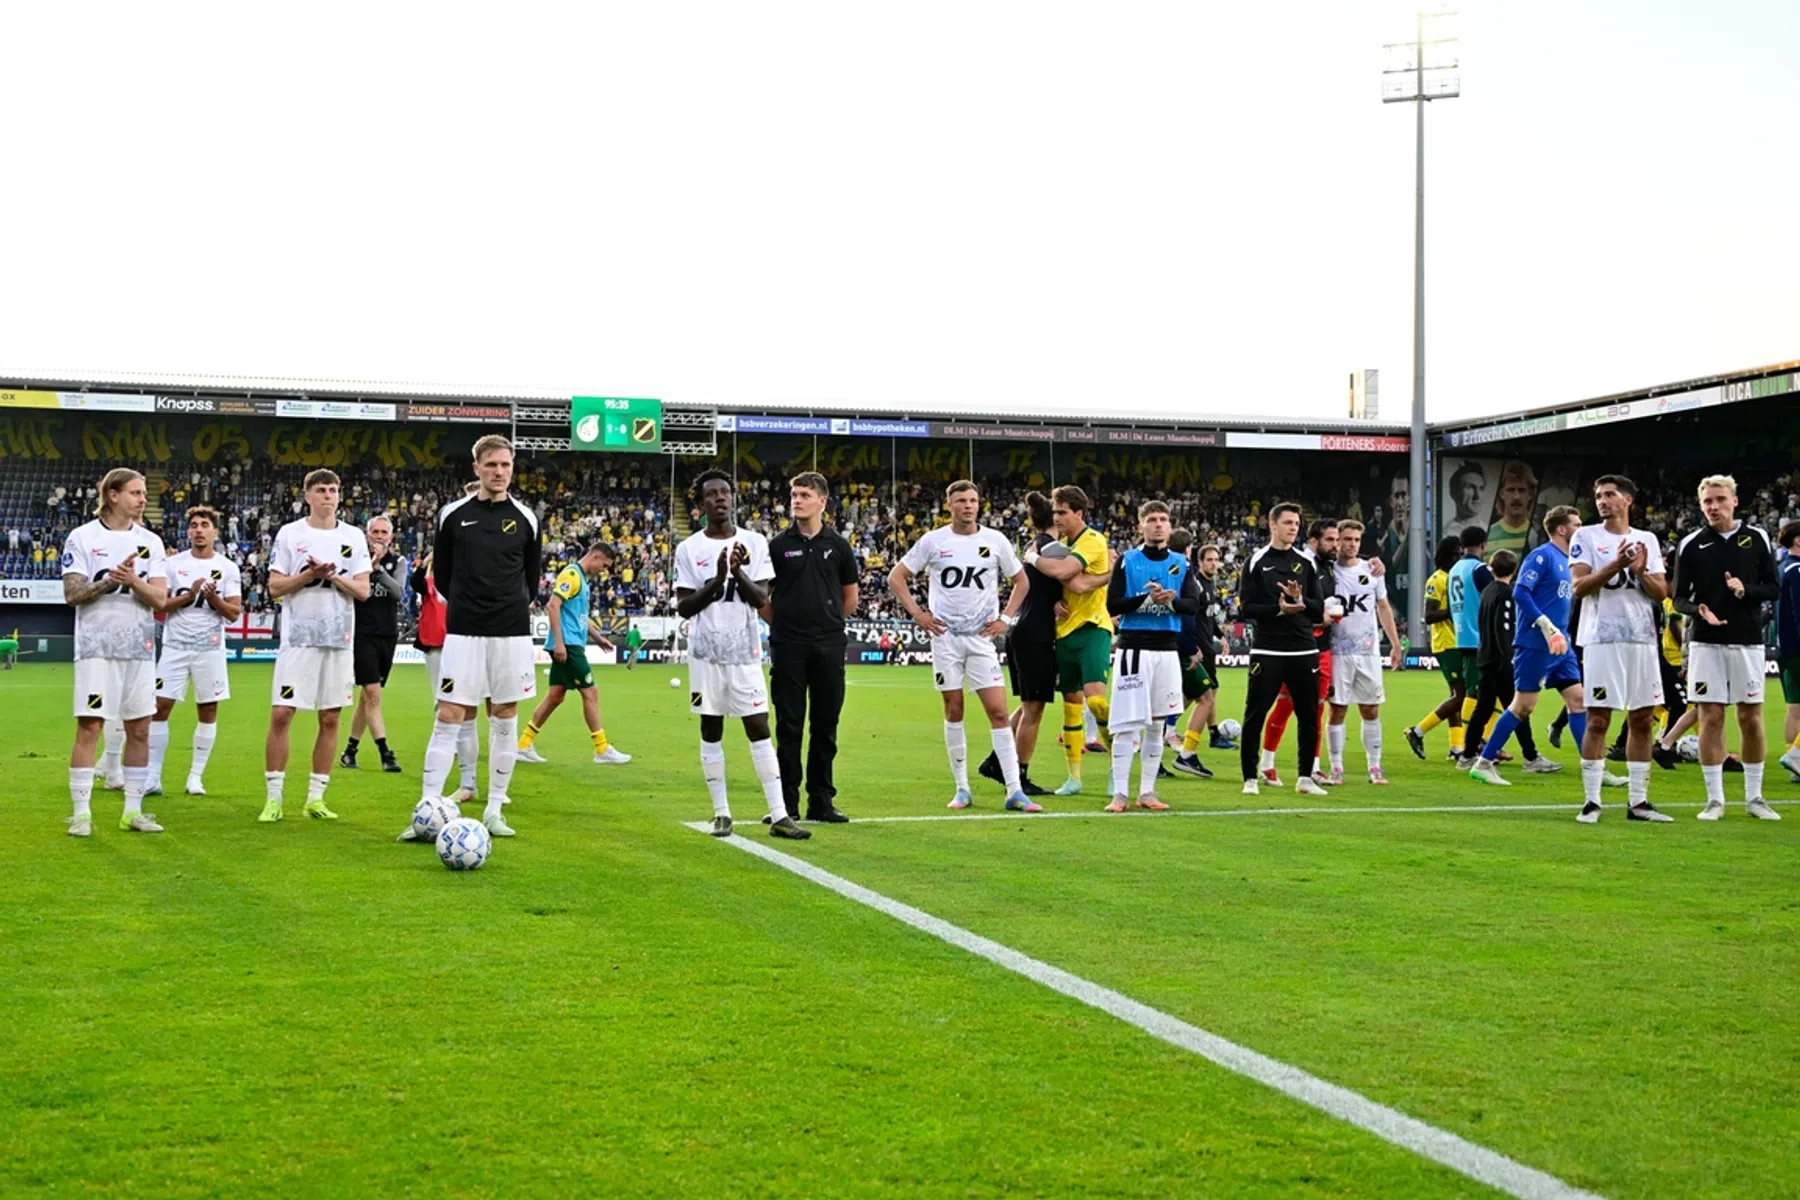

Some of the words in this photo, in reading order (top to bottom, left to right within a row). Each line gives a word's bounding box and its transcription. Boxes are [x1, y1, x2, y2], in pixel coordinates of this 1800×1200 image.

[408, 406, 435, 415] ZUIDER
[448, 407, 510, 417] ZONWERING
[739, 418, 828, 431] bsbverzekeringen.nl
[852, 422, 926, 433] bsbhypotheken.nl
[1504, 419, 1556, 439] Nederland
[941, 566, 989, 590] OK
